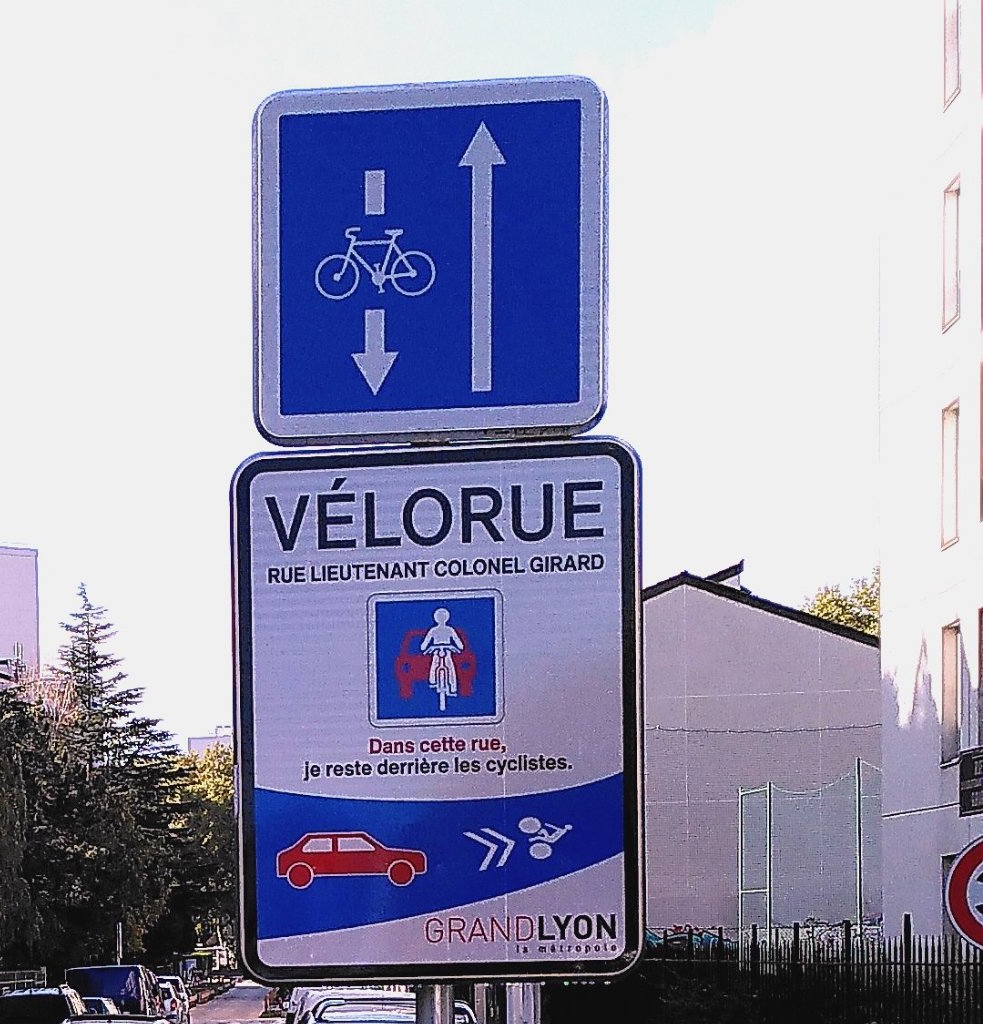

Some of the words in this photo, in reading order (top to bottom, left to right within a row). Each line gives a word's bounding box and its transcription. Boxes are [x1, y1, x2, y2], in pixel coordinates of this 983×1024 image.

[265, 478, 605, 552] VÉLORUE
[268, 567, 306, 584] RUE
[310, 561, 429, 583] LIEUTENANT
[434, 556, 526, 578] COLONEL
[529, 554, 605, 573] GIRARD
[369, 738, 415, 754] Dans
[419, 736, 466, 753] cette
[471, 738, 507, 754] rue,
[303, 761, 321, 780] je
[325, 761, 372, 777] reste
[377, 757, 449, 775] derrière
[454, 756, 481, 773] les
[486, 755, 573, 776] cyclistes.
